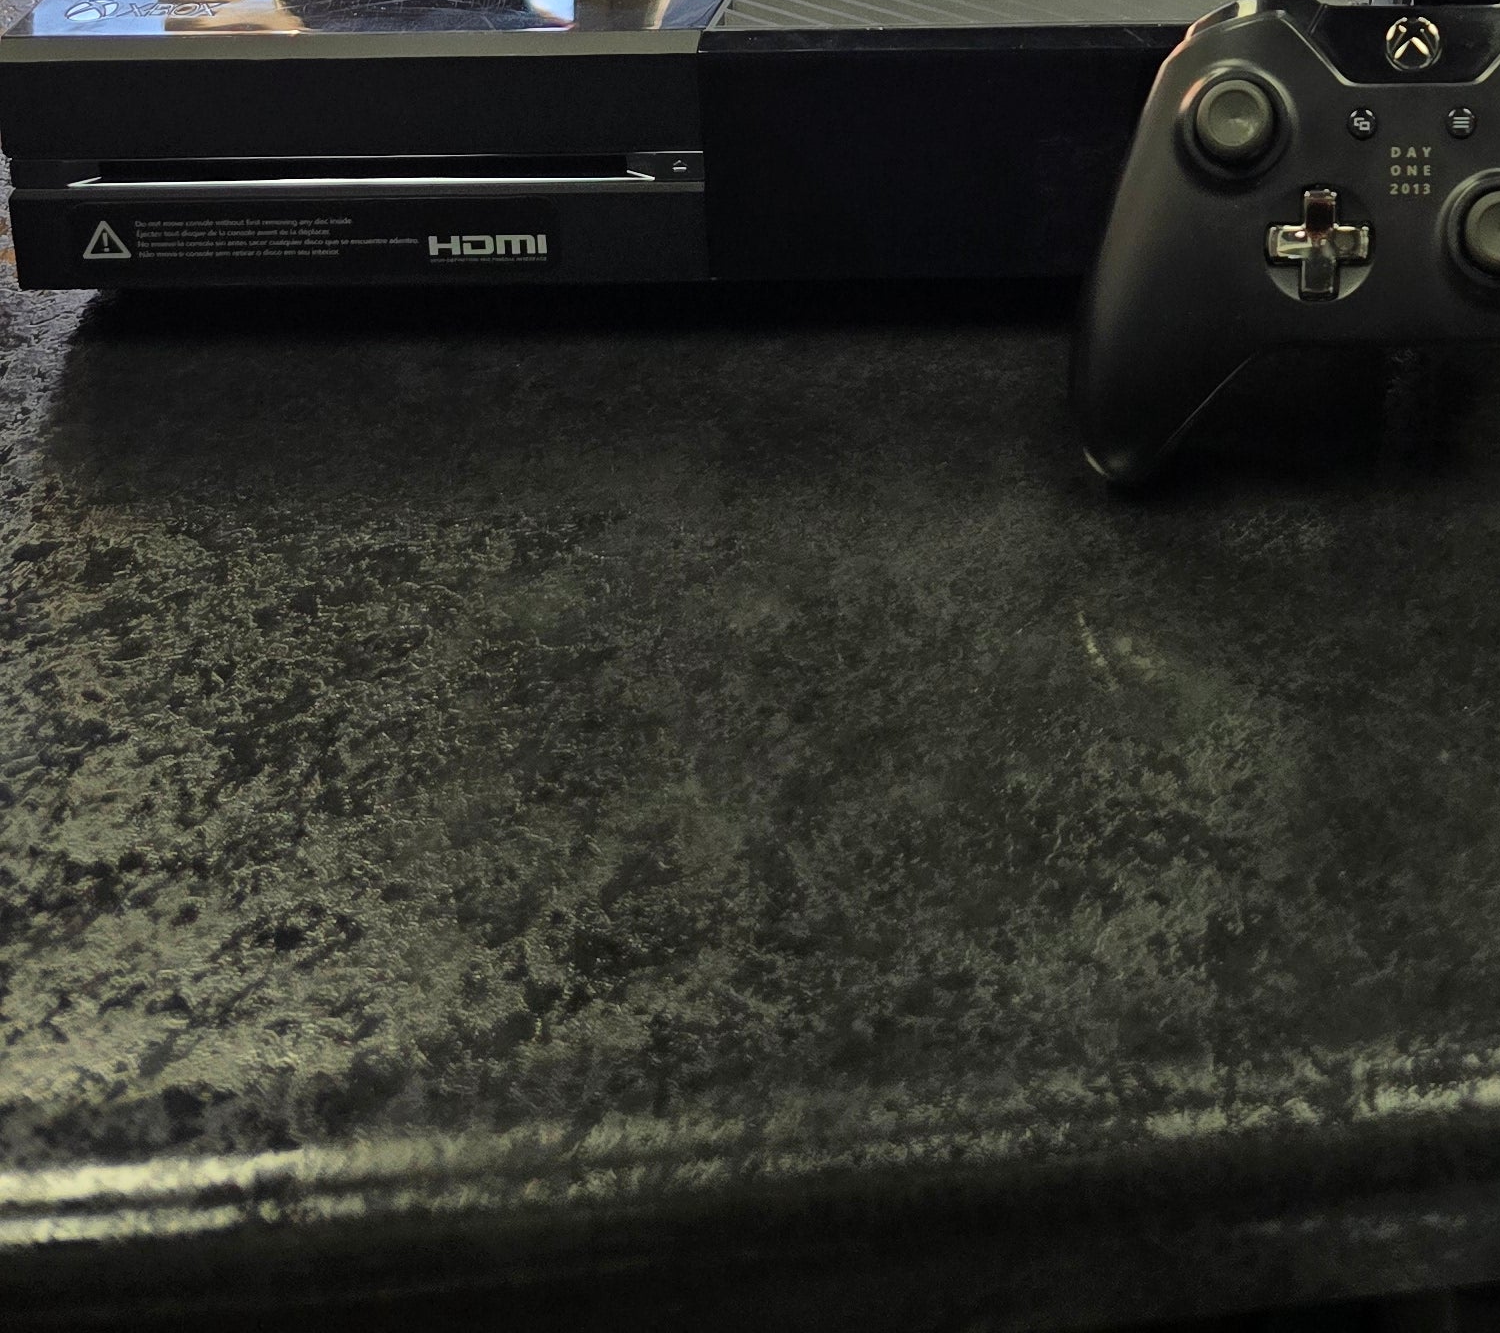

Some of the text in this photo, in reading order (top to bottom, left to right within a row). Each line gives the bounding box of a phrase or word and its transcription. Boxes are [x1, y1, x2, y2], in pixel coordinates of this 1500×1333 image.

[117, 1, 230, 18] XBOX
[1390, 146, 1432, 159] DAY
[1390, 164, 1432, 177] ONE
[1390, 182, 1432, 195] 2013
[428, 234, 548, 256] HDMI
